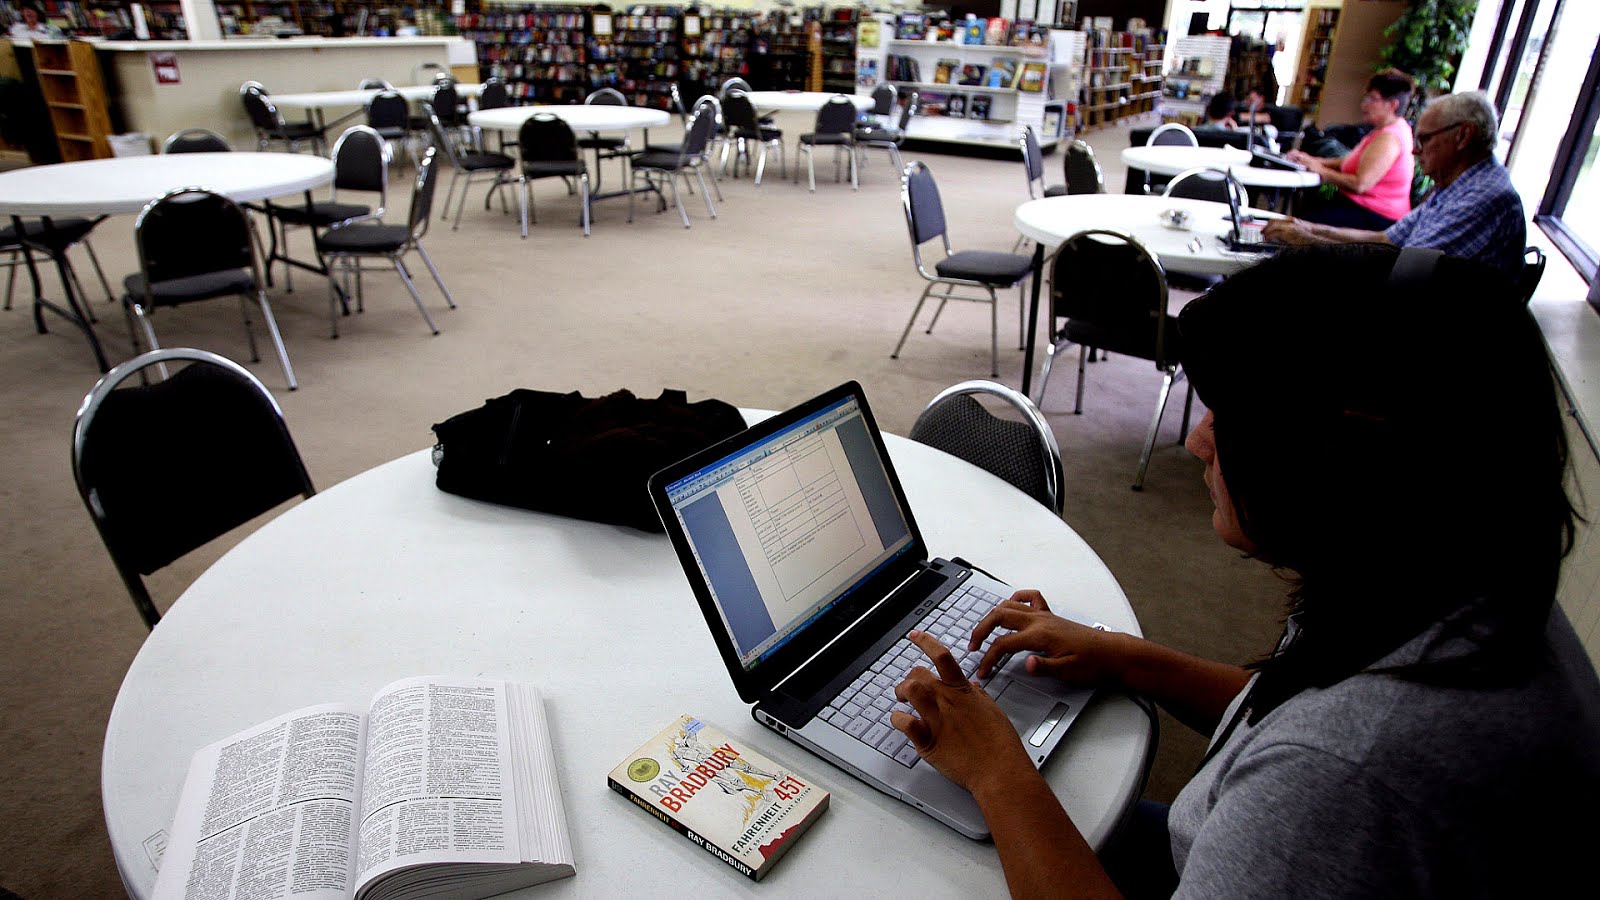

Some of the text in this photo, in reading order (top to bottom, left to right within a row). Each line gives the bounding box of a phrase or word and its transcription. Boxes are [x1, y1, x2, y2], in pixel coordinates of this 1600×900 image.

[649, 770, 680, 797] RAY
[660, 743, 740, 813] BRADBURY
[629, 794, 670, 824] FAHRENHEIT
[731, 776, 806, 853] FAHRENHEIT 451
[687, 830, 752, 877] RAY BRADBURY
